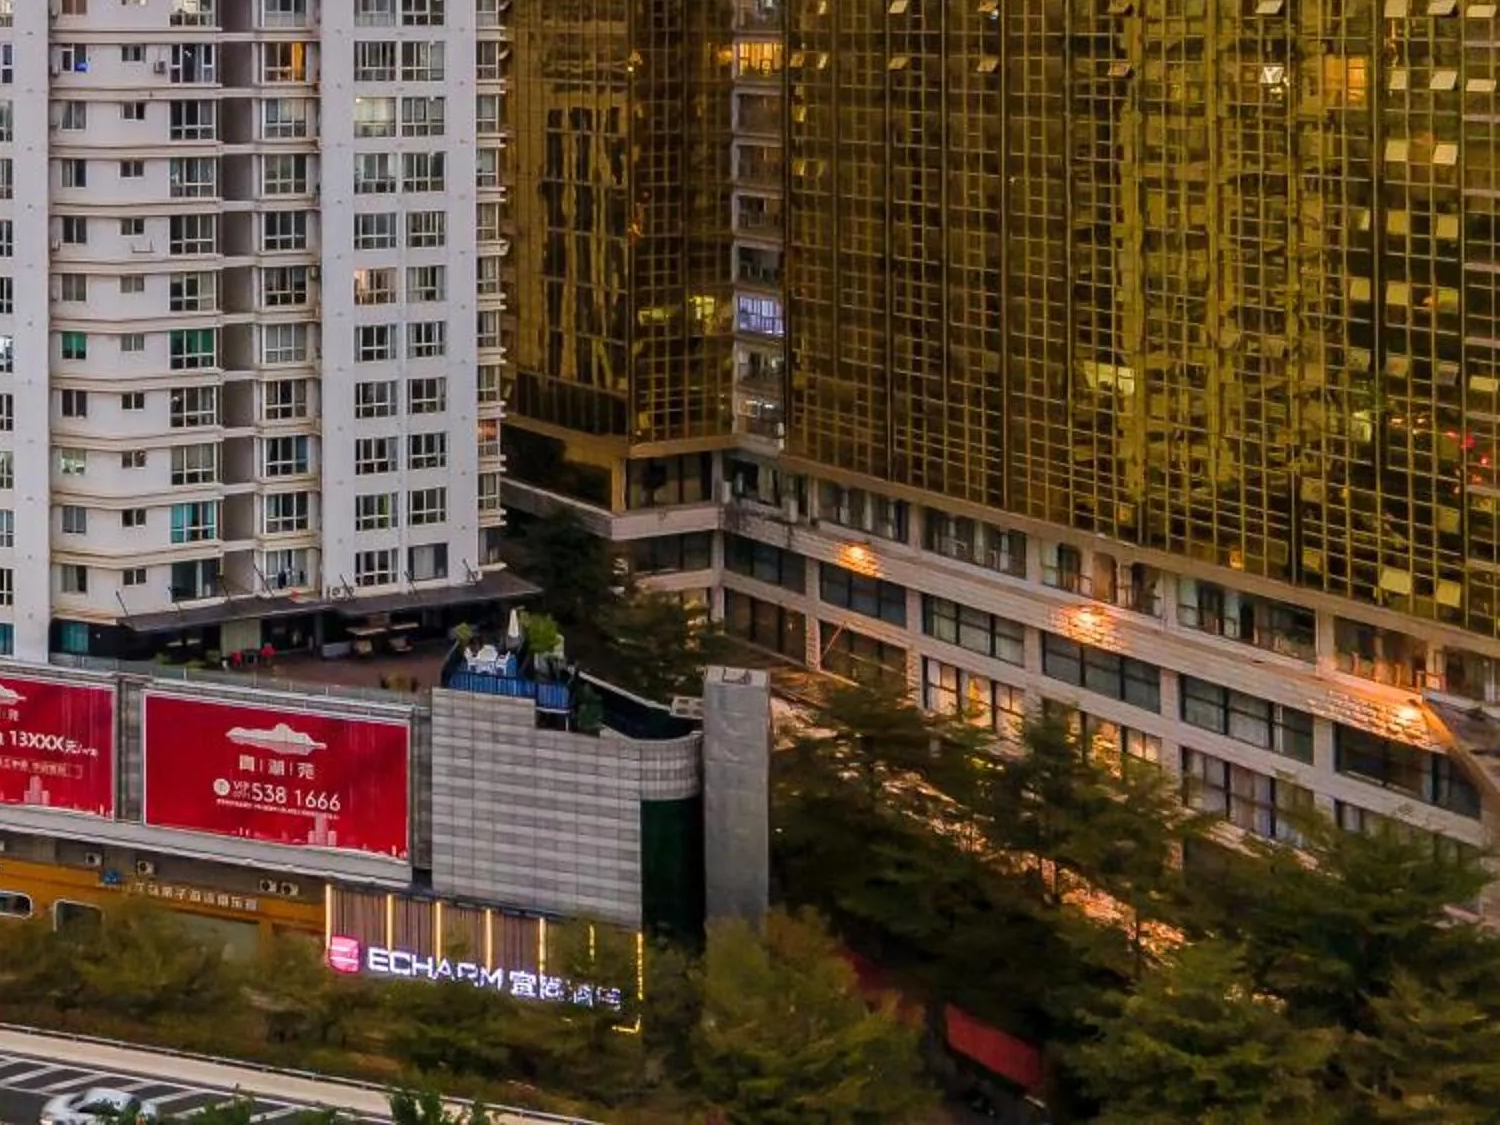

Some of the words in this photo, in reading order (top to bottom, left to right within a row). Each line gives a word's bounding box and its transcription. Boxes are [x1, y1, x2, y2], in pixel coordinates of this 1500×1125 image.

[251, 783, 287, 804] 538
[294, 790, 341, 812] 1666
[368, 946, 504, 992] ECHARM
